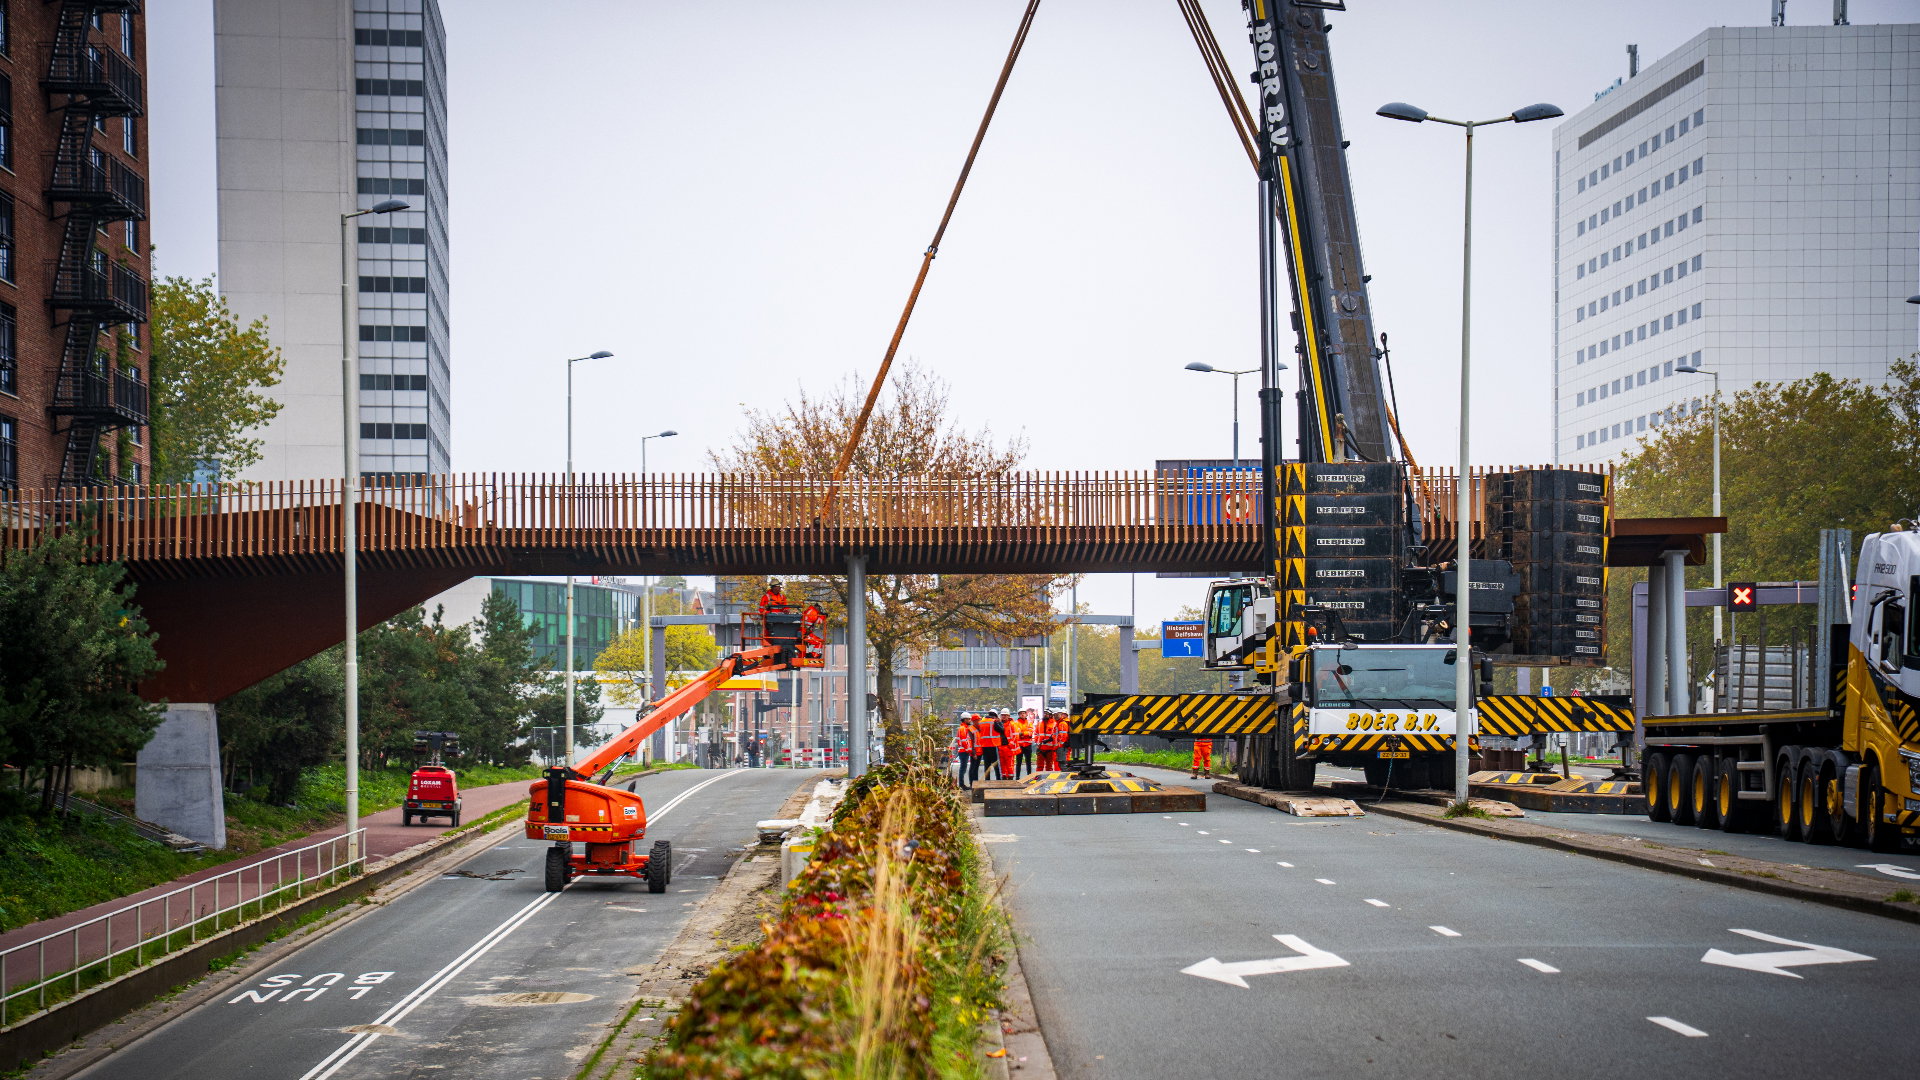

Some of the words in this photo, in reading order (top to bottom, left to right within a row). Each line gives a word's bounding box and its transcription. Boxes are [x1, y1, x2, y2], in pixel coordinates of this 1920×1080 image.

[1255, 22, 1281, 98] BOER
[1266, 102, 1289, 153] B.V.
[1345, 712, 1399, 732] BOER
[1403, 712, 1440, 732] B.V.
[544, 826, 568, 834] Boels
[259, 971, 396, 988] BUS
